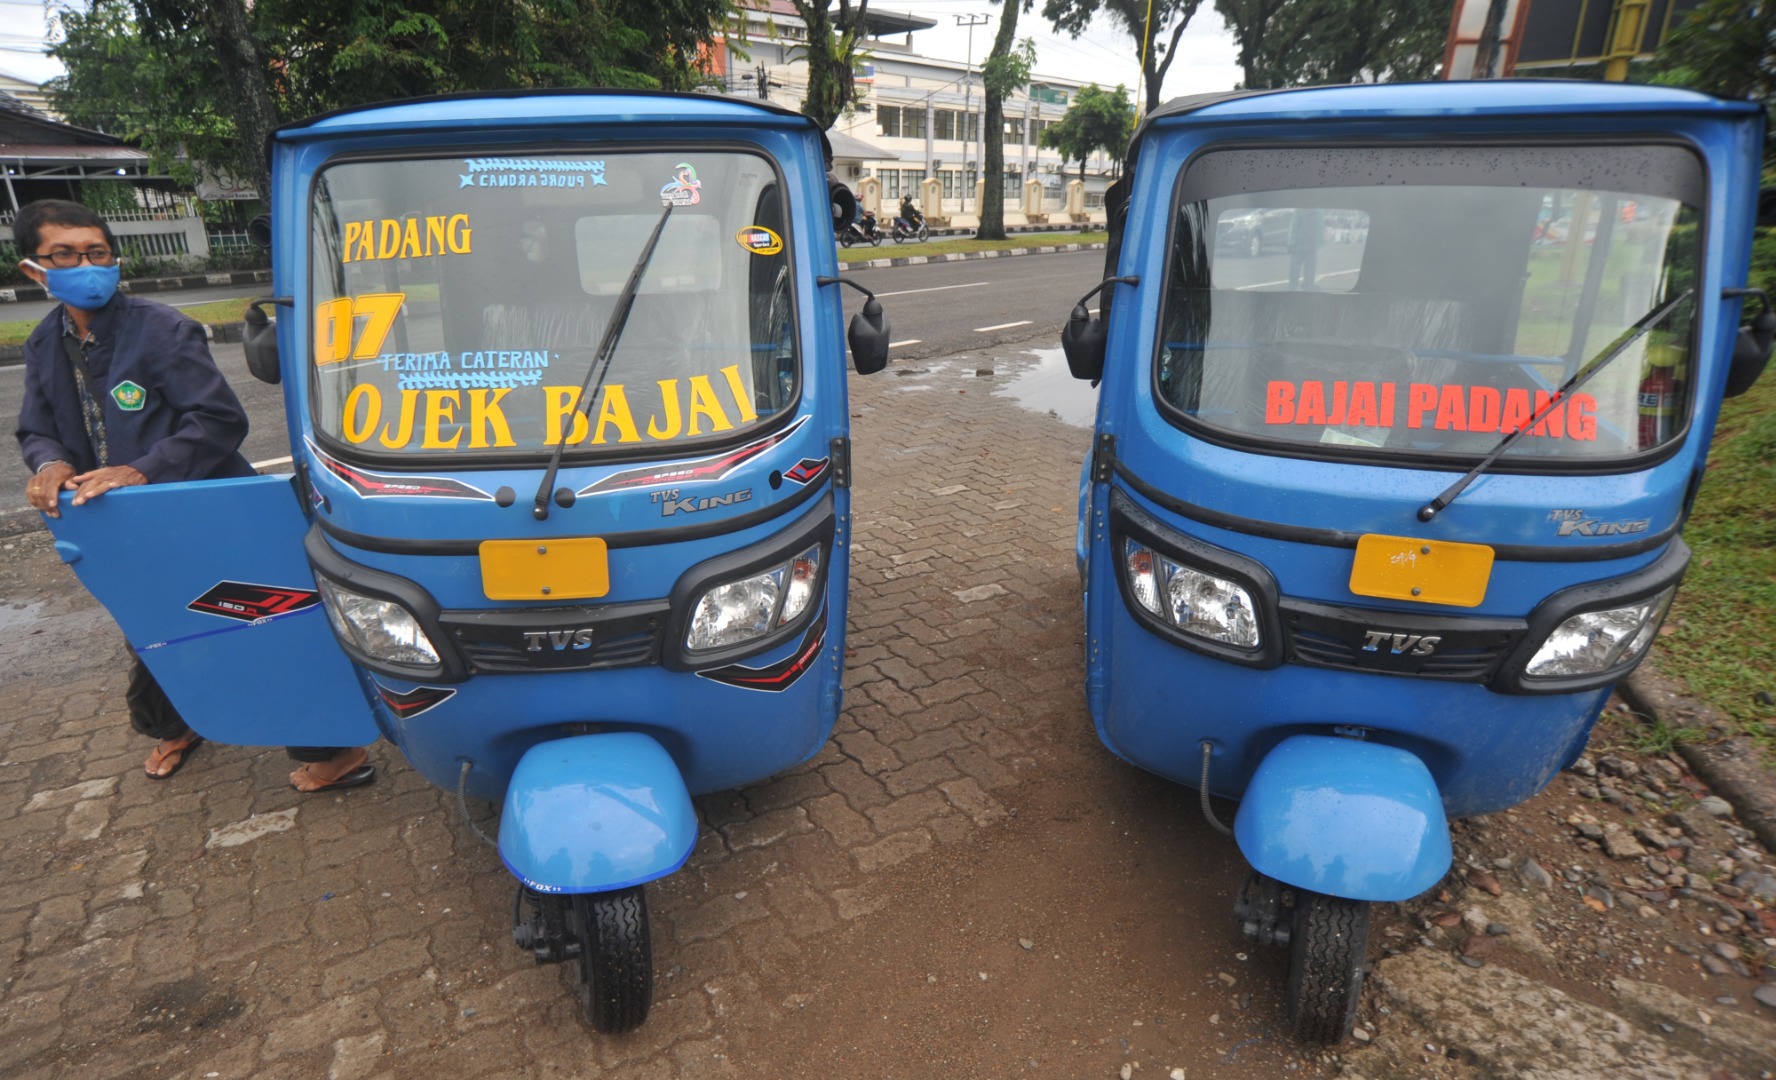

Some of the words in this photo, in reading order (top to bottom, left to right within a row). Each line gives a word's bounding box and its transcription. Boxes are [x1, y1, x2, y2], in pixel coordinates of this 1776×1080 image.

[342, 213, 472, 264] PADANG
[314, 292, 406, 366] 07
[382, 351, 452, 372] TERIMA
[460, 350, 549, 370] CATERAN
[342, 383, 516, 450] OJEK
[543, 365, 759, 446] BAJAI
[1265, 381, 1396, 428] BAJAI
[1407, 383, 1598, 441] PADANG
[650, 488, 680, 503] TVS
[1551, 509, 1584, 520] TVS
[523, 628, 593, 651] TVS
[1361, 630, 1442, 656] TVS
